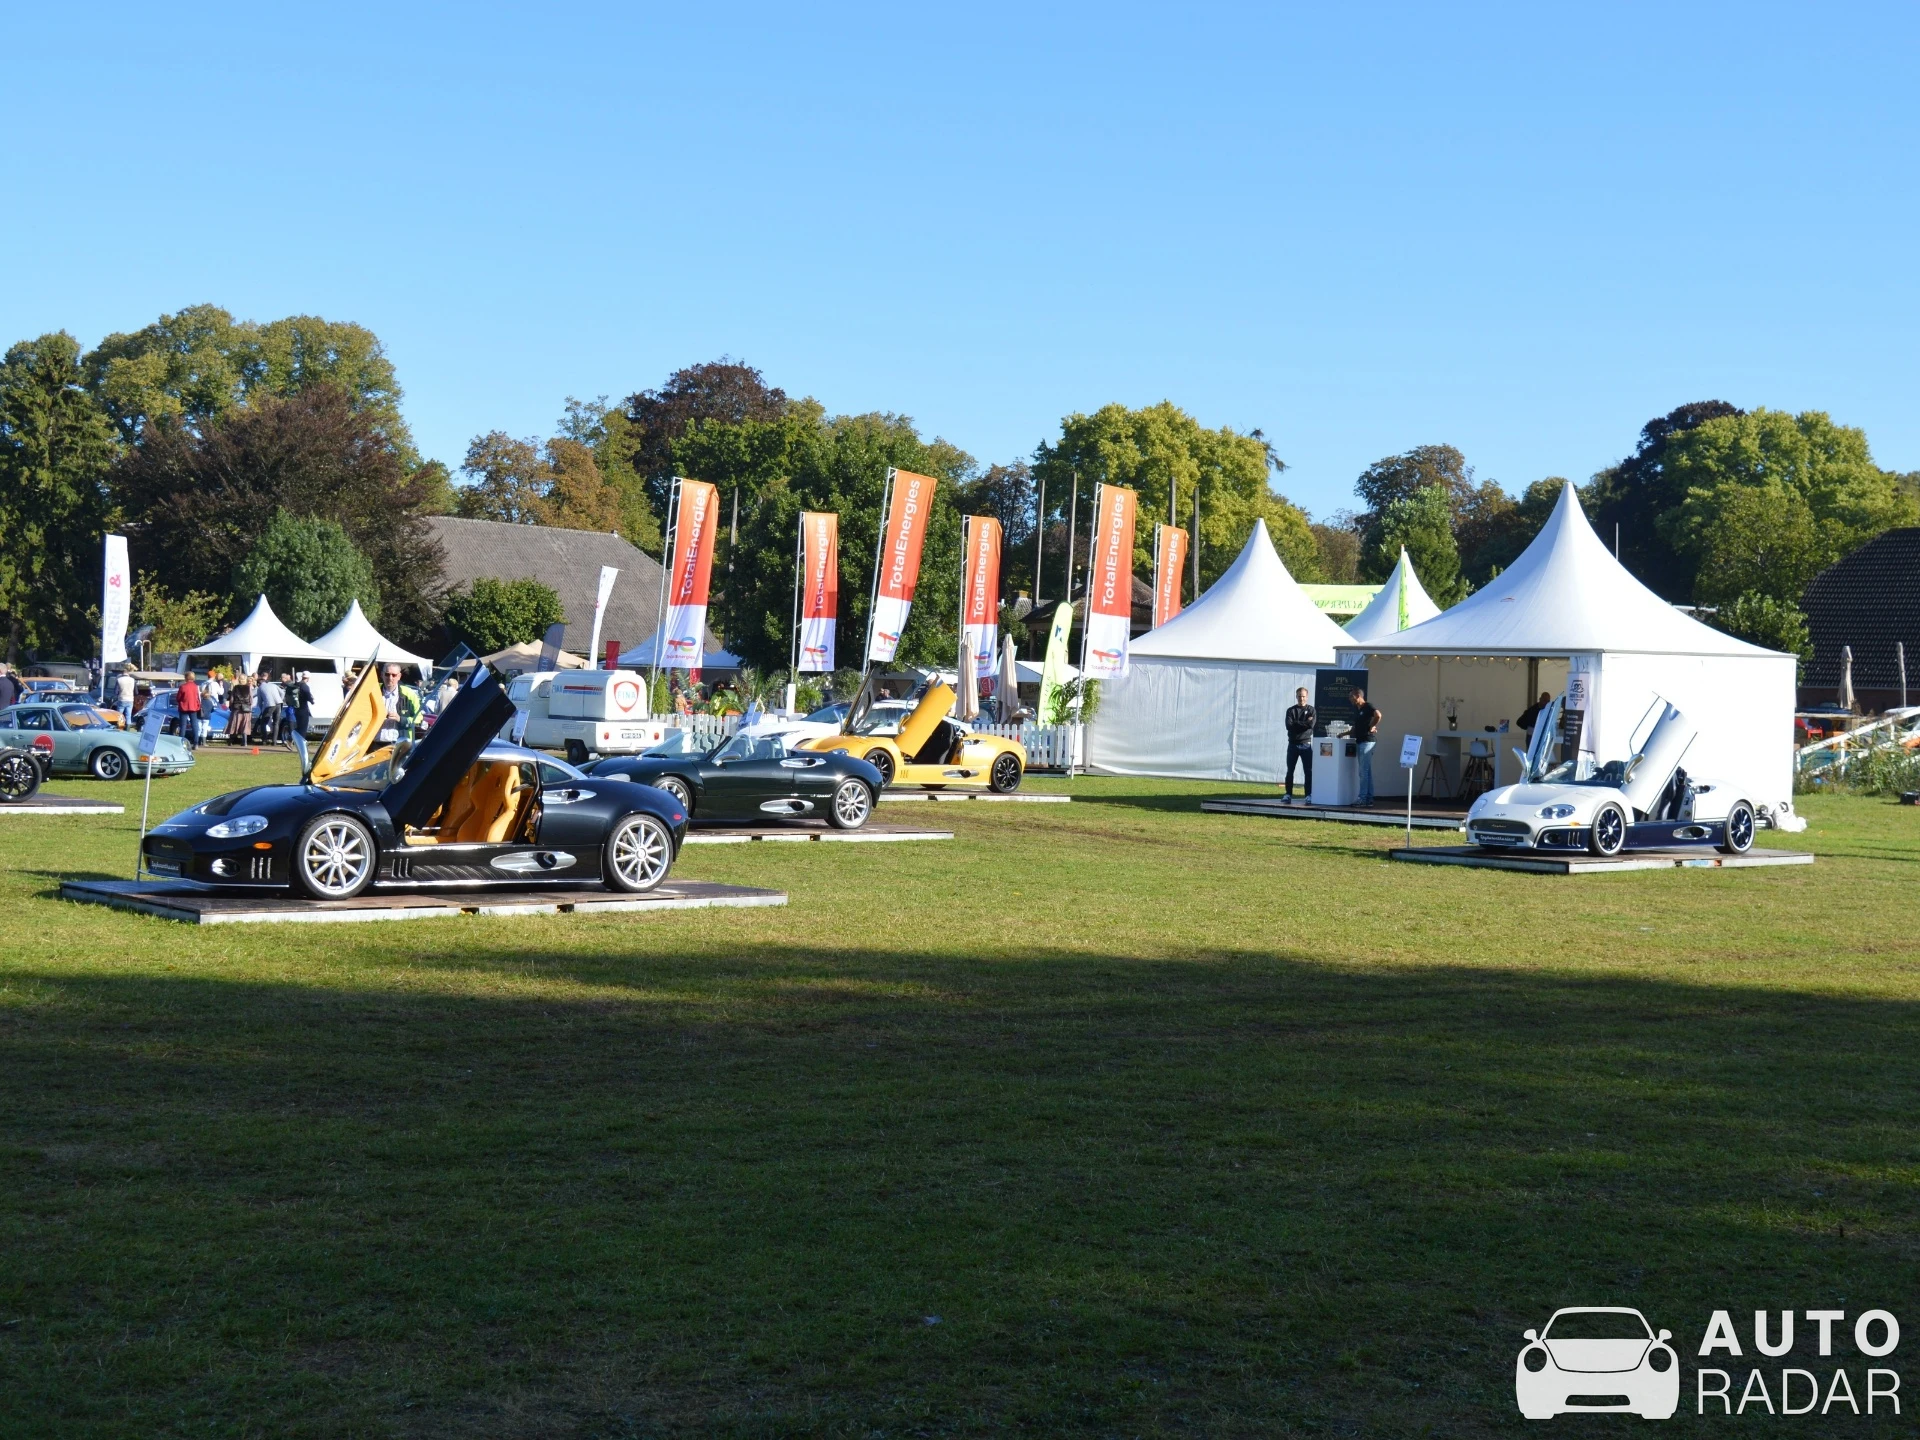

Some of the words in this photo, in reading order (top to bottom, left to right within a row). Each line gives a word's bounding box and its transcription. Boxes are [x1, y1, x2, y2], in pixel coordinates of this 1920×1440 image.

[109, 574, 121, 588] &
[681, 488, 707, 599] TotalEnergies
[815, 517, 829, 609] TotalEnergies
[889, 479, 922, 591] TotalEnergies
[973, 522, 991, 618] TotalEnergies
[1102, 493, 1125, 609] TotalEnergies
[617, 690, 636, 699] FINA
